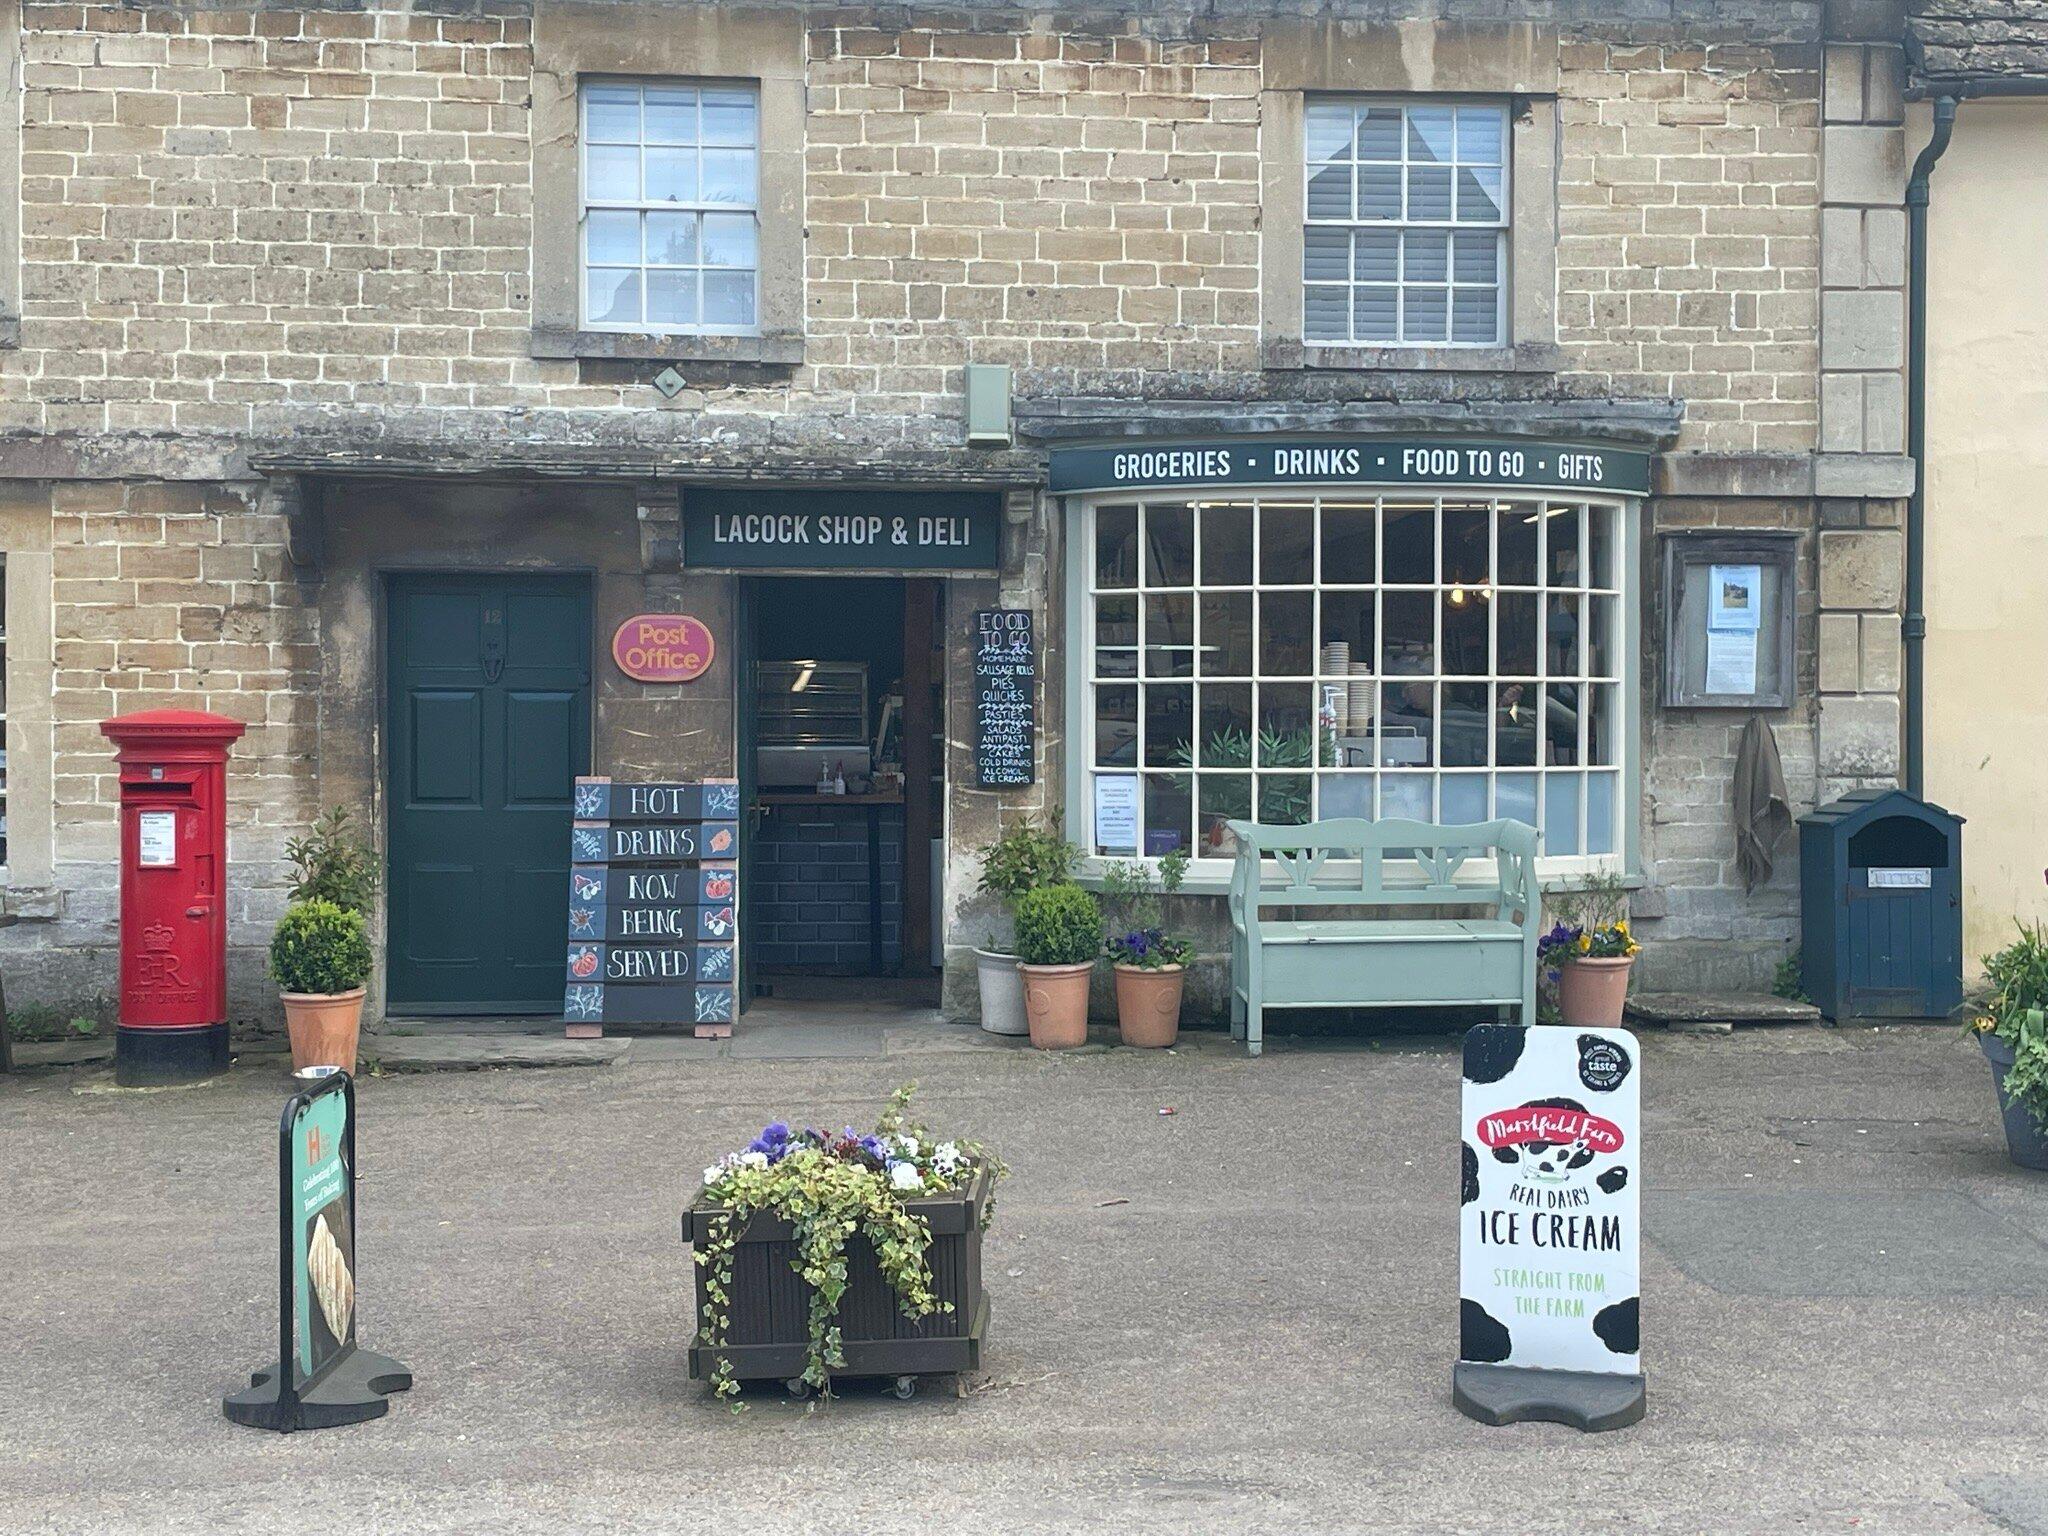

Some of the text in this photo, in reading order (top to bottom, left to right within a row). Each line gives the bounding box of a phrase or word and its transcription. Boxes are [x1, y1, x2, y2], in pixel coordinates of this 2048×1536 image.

[1113, 448, 1603, 481] GROCERIES DRINKS FOOD TO GO GIFTS
[713, 514, 970, 546] LACOCK SHOP & DELI
[979, 613, 1030, 631] FOOD
[640, 623, 689, 645] Post
[979, 631, 1030, 647] TO GO
[625, 647, 701, 670] Office
[982, 655, 1027, 663] HOMEMADE
[976, 665, 1035, 675] SAUSAGE ROLLS
[991, 678, 1015, 689] PIES
[982, 690, 1025, 702] QUICHES
[984, 710, 1024, 720] PASTIES
[981, 735, 1027, 744] ANTIPASTI
[987, 726, 1022, 735] SALADS
[979, 757, 1032, 768] COLD DRINKS
[988, 750, 1021, 758] CAKES
[982, 775, 1030, 784] ICE CREAMS
[983, 767, 1025, 776] ALCOHOL
[630, 787, 685, 815] HOT
[614, 828, 695, 856] DRINKS
[628, 874, 680, 900] NOW
[1875, 872, 1926, 885] LITTER
[620, 908, 684, 939] BEING
[606, 949, 689, 978] SERVED
[1588, 1061, 1617, 1072] taste
[1580, 1118, 1617, 1146] Farm
[1509, 1183, 1590, 1209] REAL DAIRY
[1480, 1210, 1621, 1252] ICE CREAM
[1493, 1268, 1606, 1293] STRAIGHT FROM
[1515, 1296, 1585, 1318] THE FARM
